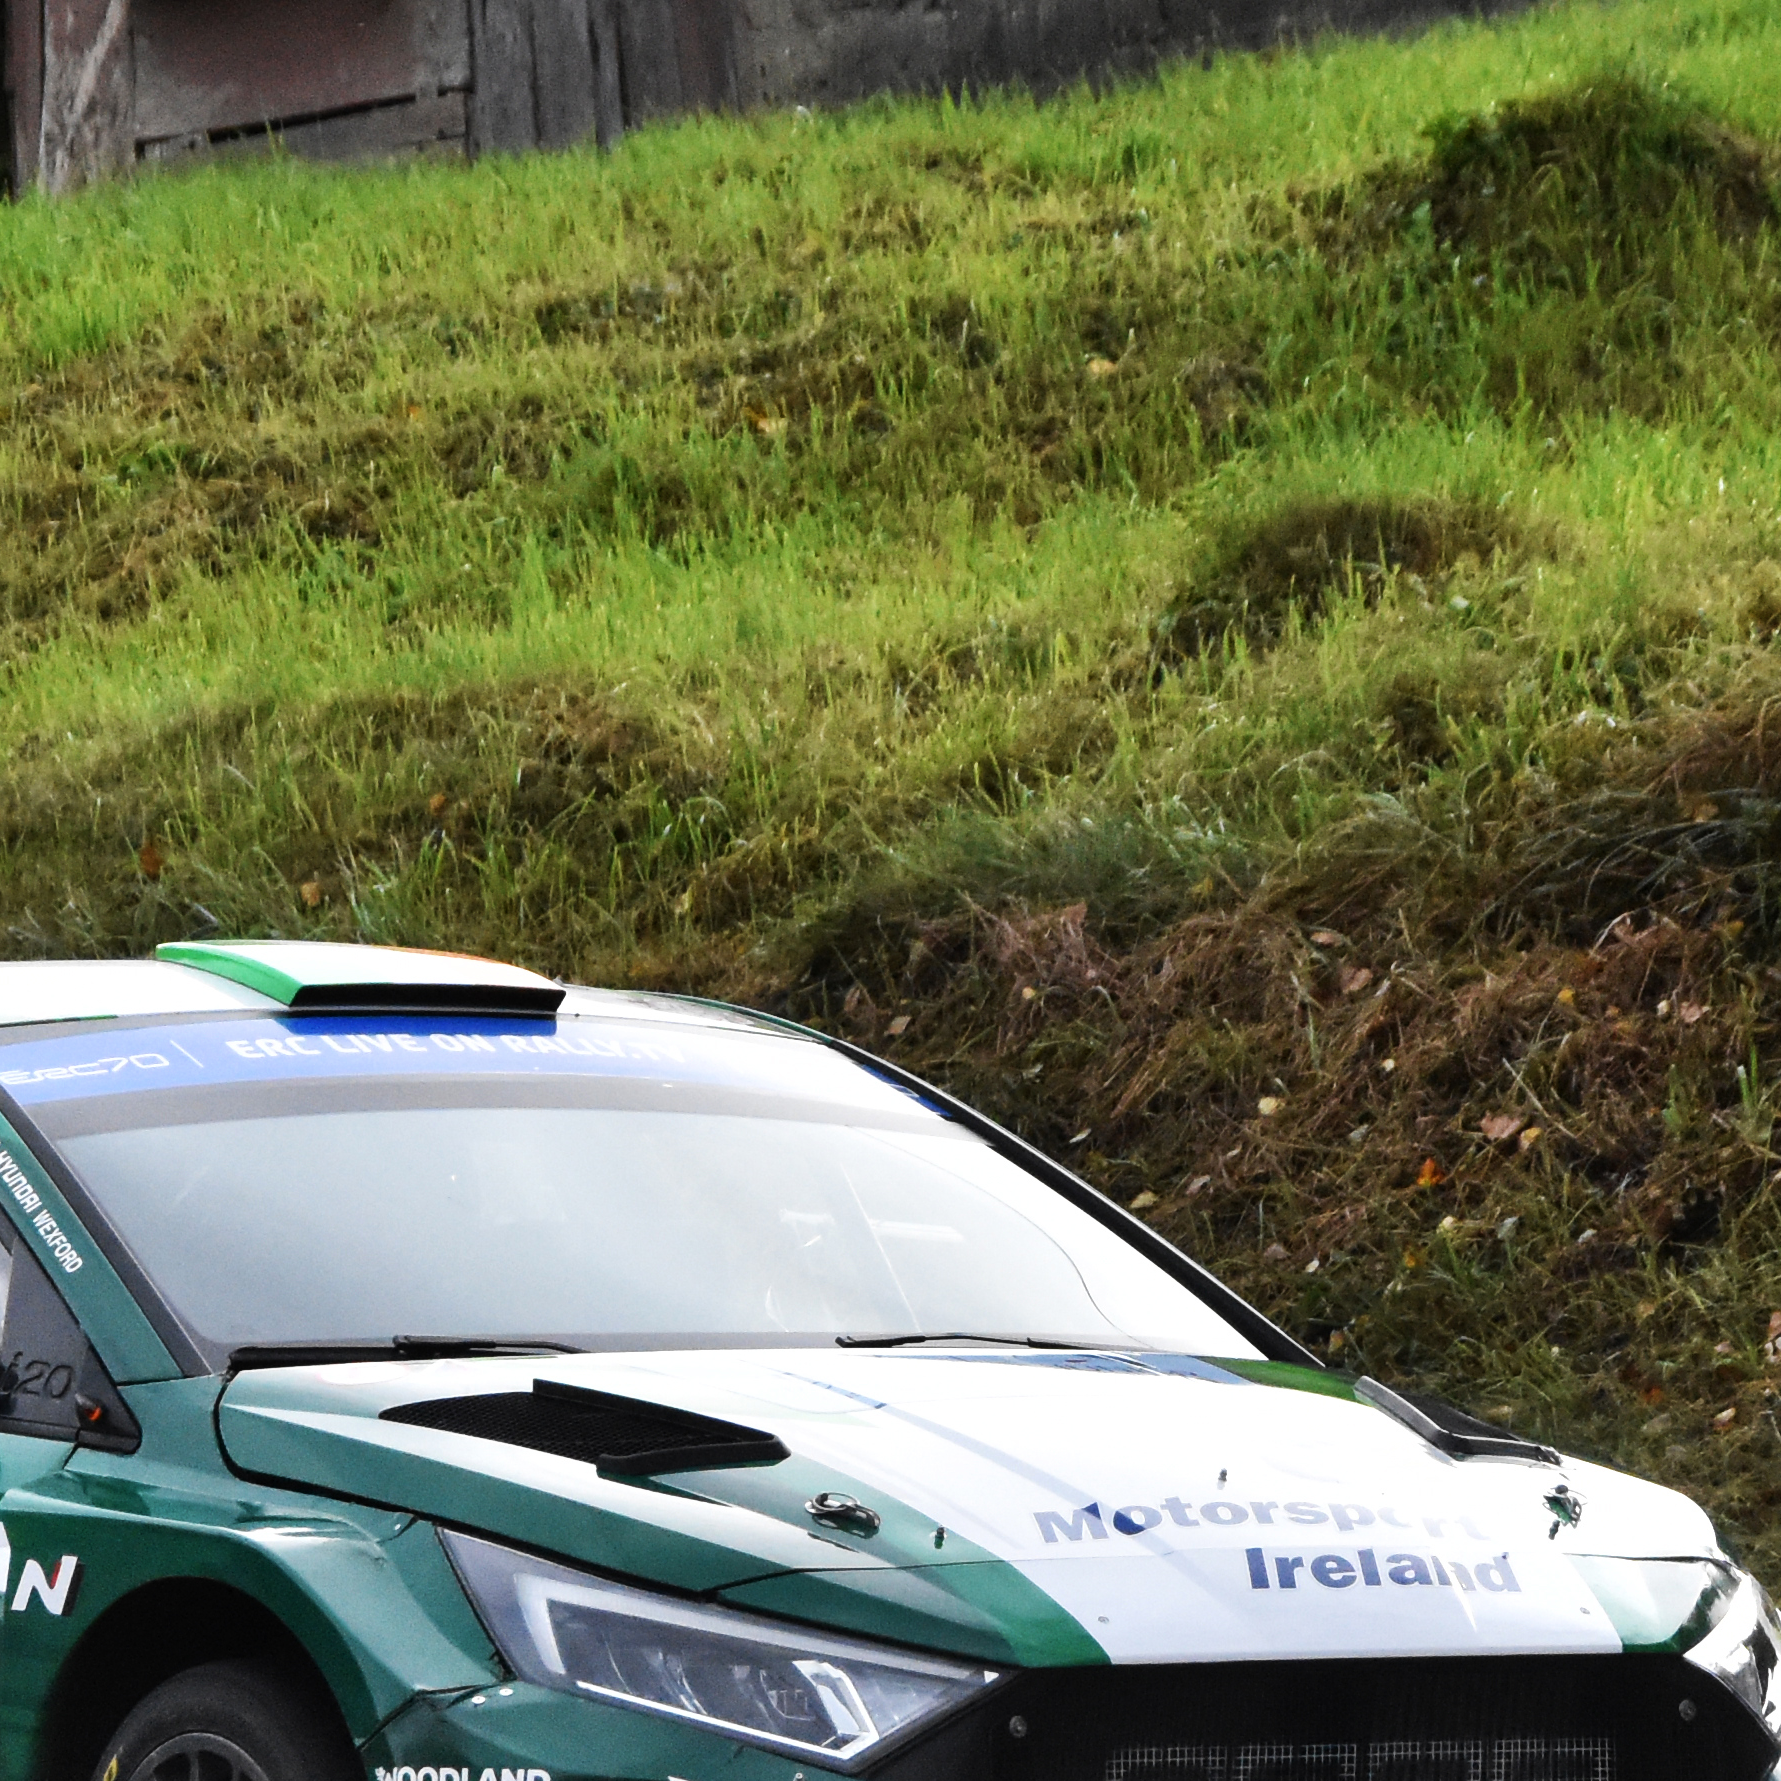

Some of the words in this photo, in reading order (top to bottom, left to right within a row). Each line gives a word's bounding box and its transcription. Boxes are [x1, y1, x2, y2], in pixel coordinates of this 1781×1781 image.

[227, 1035, 321, 1059] ERC
[321, 1033, 427, 1054] LIVE
[428, 1033, 494, 1053] ON
[32, 1208, 84, 1273] WEXFORD
[1032, 1495, 1494, 1544] Motorsport
[10, 1554, 85, 1617] N
[1244, 1547, 1523, 1594] Ireland
